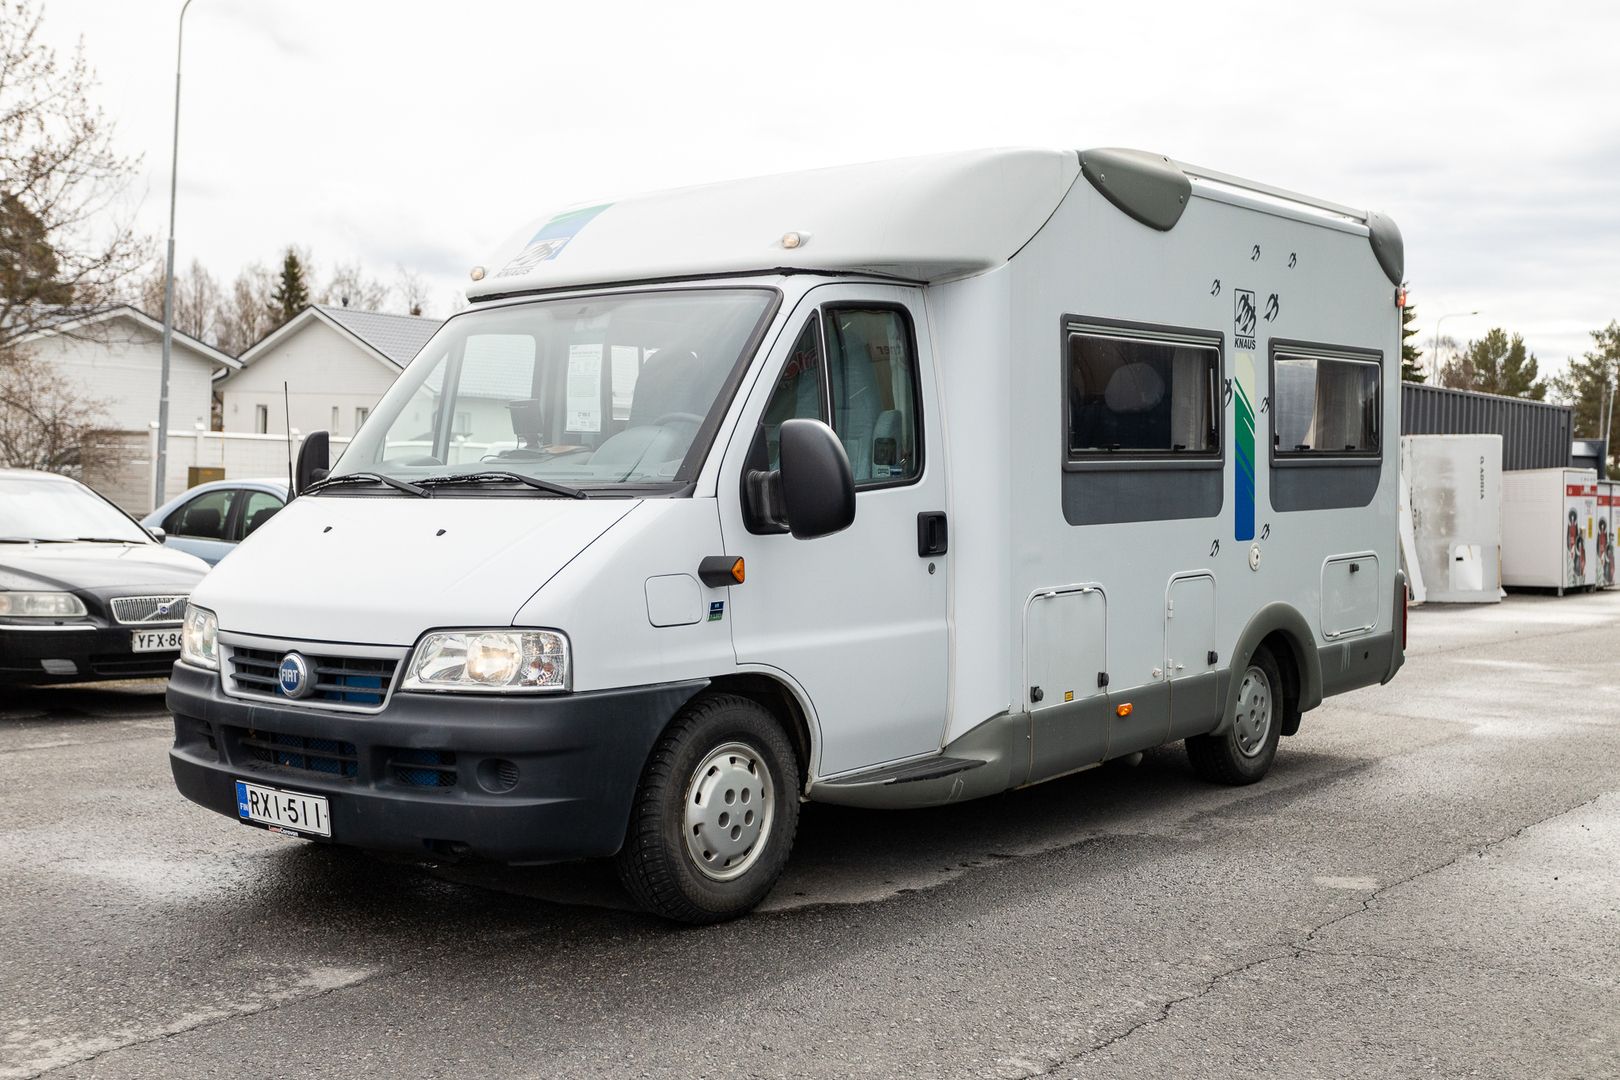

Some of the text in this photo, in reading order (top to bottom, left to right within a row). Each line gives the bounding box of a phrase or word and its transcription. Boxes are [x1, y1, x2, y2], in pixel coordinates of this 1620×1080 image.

[1234, 337, 1256, 350] KNAUS
[281, 668, 298, 683] FIAT
[249, 789, 321, 828] RXI-511
